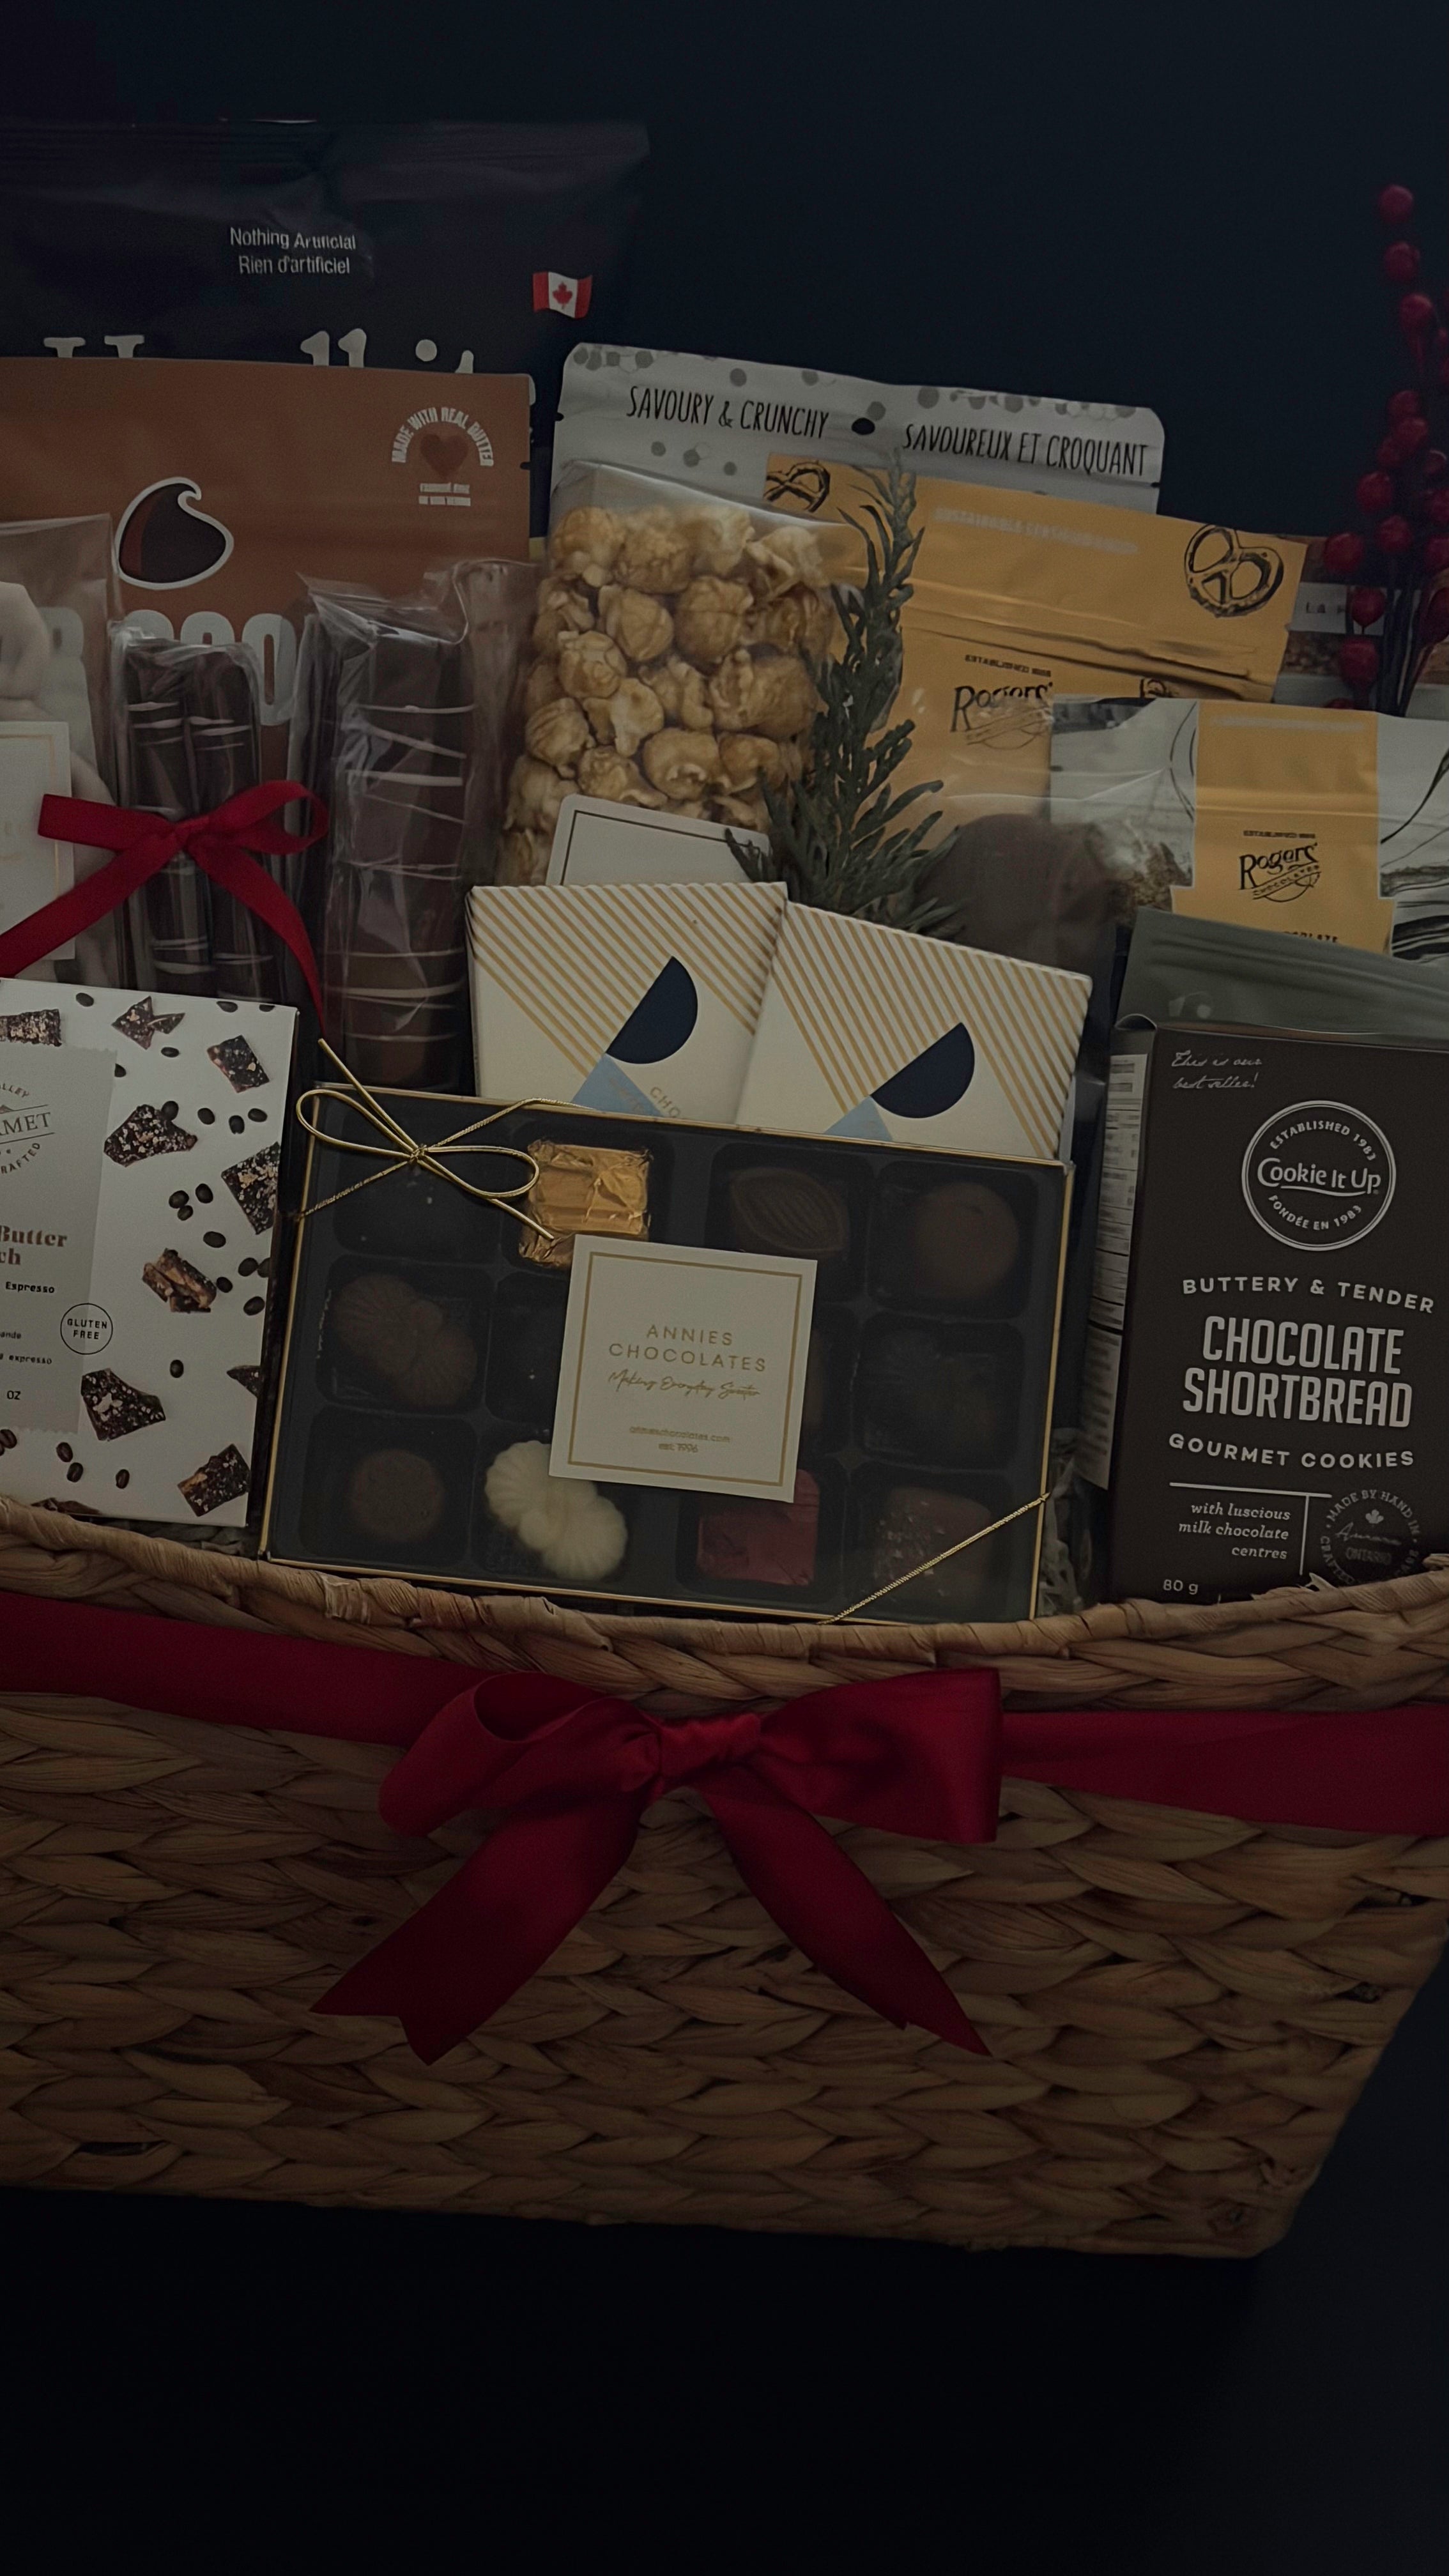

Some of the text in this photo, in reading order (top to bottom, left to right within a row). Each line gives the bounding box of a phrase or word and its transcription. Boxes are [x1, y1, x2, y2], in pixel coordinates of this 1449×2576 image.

[230, 227, 289, 249] Nothing
[238, 255, 350, 275] Rien d'artificiel
[407, 407, 438, 431] WITH
[626, 385, 829, 439] SAVOURY & CRUNCHY
[902, 423, 1150, 477] SAVOUREUX ET CROQUANT
[1172, 1050, 1208, 1067] This
[1213, 1053, 1230, 1066] is
[0, 1083, 29, 1098] LLEY
[1269, 1120, 1376, 1161] ESTABLISHED 1983
[0, 1142, 40, 1174] RAFTED
[1257, 1157, 1382, 1195] Cookie It Up
[1268, 1195, 1362, 1230] FONDÉE EN 1983
[5, 1281, 55, 1294] Espresso
[1182, 1276, 1434, 1314] BUTTERY & TENDER
[0, 1331, 22, 1340] ande
[67, 1318, 107, 1330] GLUTEN
[73, 1330, 99, 1340] FREE
[646, 1324, 733, 1346] ANNIES
[1202, 1315, 1404, 1375] CHOCOLATE
[608, 1343, 766, 1372] CHOCOLATES
[1182, 1367, 1413, 1428] SHORTBREAD
[1168, 1432, 1415, 1469] GOURMET COOKIES
[1190, 1501, 1291, 1521] with luscious
[1326, 1489, 1421, 1534] MADE BY HAND IN
[1179, 1520, 1289, 1541] milk chocolate
[1231, 1545, 1288, 1560] centres
[1163, 1579, 1199, 1595] 80 g
